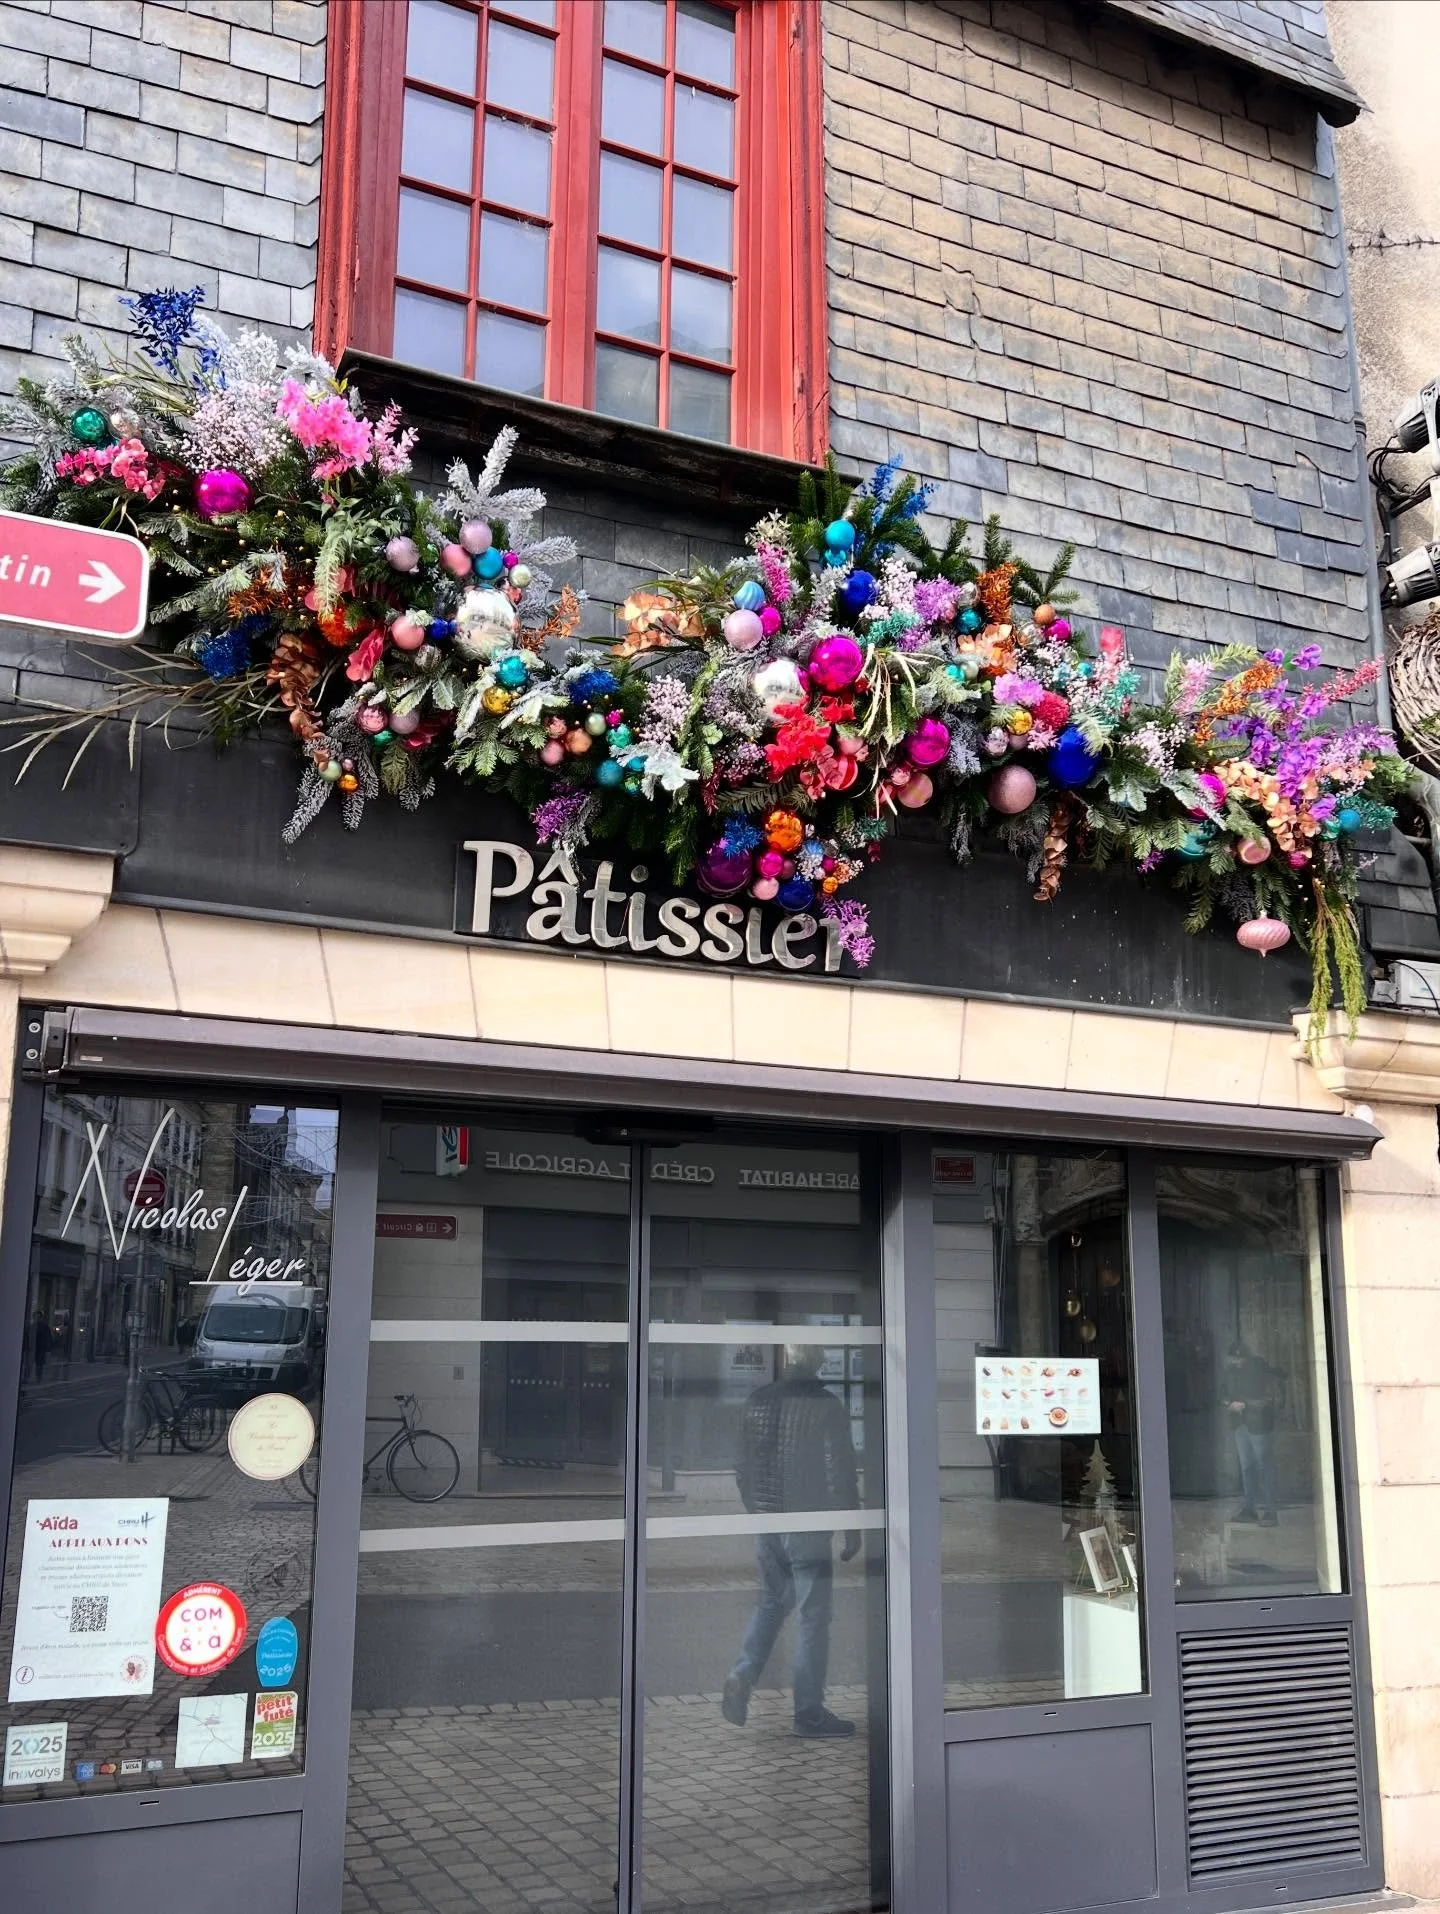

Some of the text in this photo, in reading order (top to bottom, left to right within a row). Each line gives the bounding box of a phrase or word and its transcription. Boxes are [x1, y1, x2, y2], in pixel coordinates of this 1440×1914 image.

[0, 554, 52, 588] tin
[61, 1107, 228, 1261] Nicolas
[189, 1184, 306, 1296] Léger
[40, 1515, 79, 1531] Aïda
[180, 1607, 223, 1622] COM
[257, 1695, 293, 1715] petit
[263, 1706, 294, 1722] futé
[10, 1735, 63, 1756] 2025
[254, 1731, 293, 1746] 2025
[8, 1766, 61, 1781] inovalys
[125, 1762, 140, 1770] VISA
